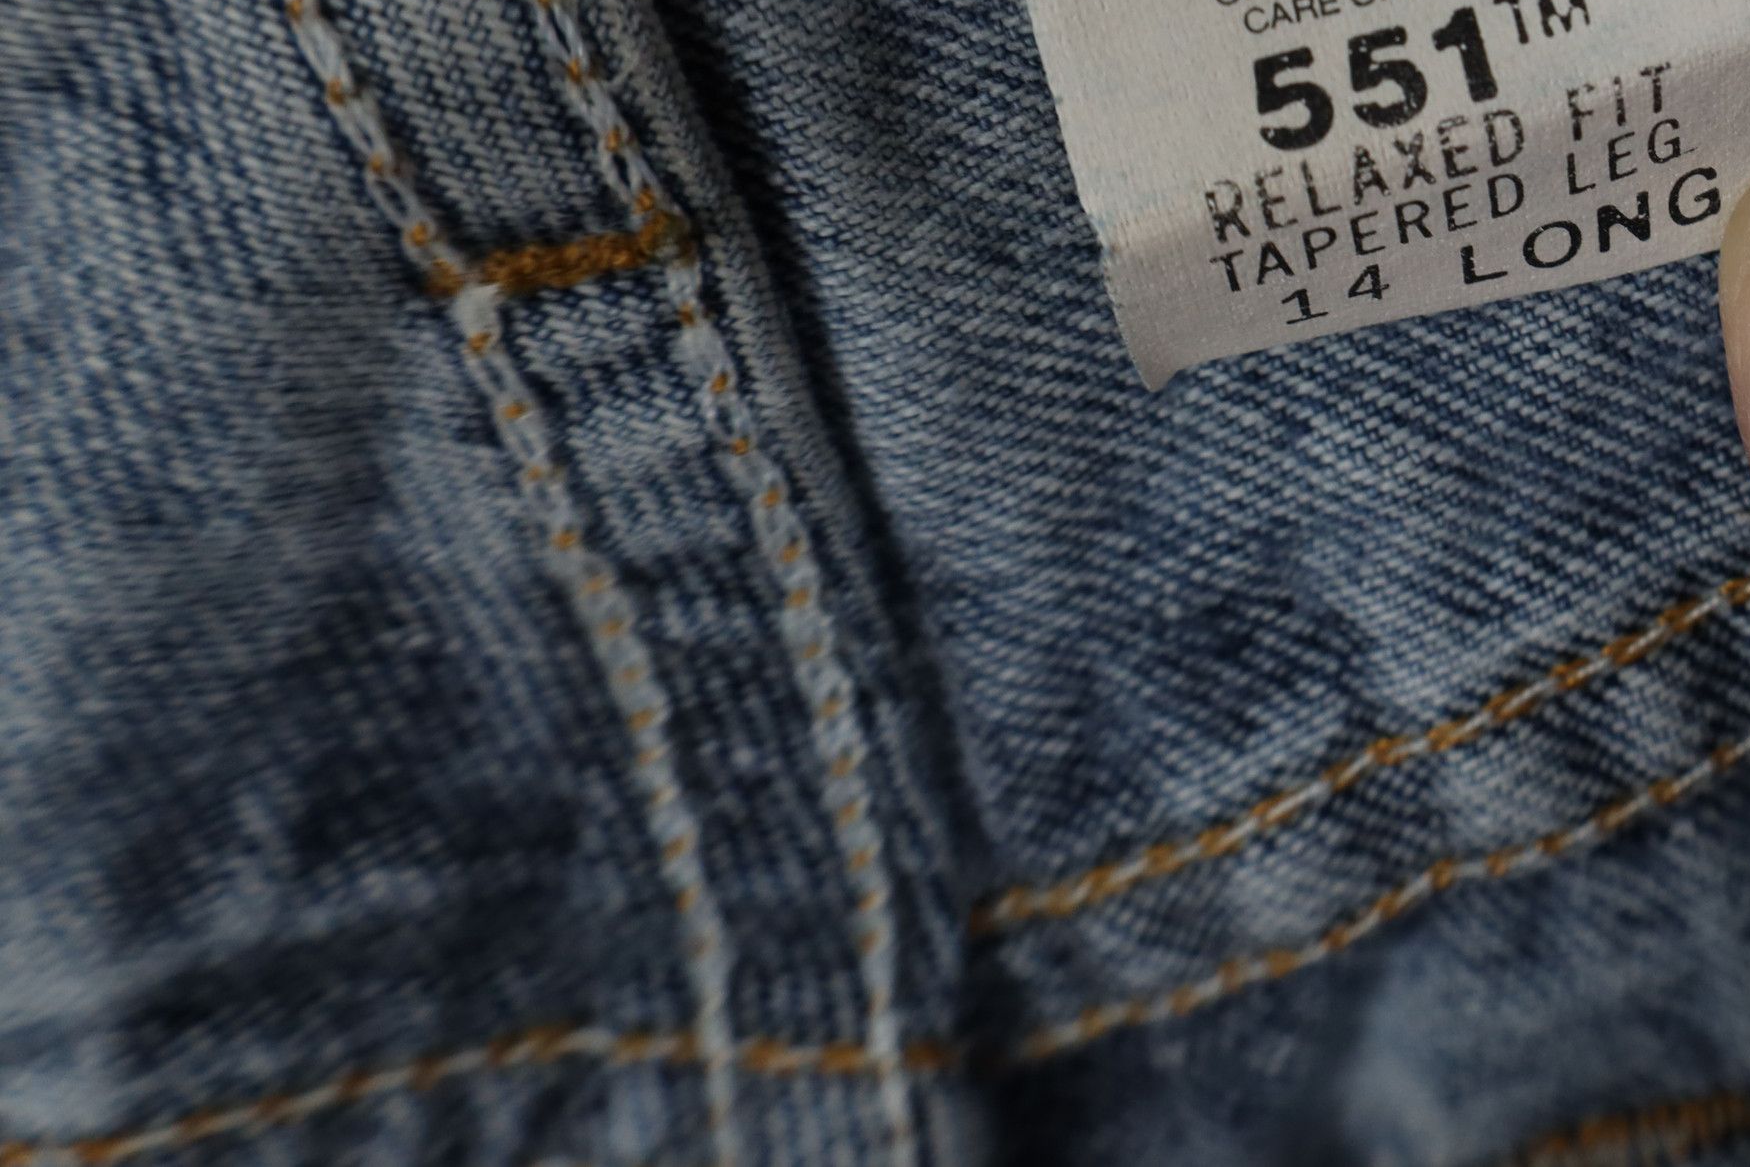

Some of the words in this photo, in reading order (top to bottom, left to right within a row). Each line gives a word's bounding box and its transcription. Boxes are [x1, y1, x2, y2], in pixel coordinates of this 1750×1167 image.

[1205, 110, 1524, 244] RELAXED
[1566, 62, 1671, 142] FIT
[1210, 172, 1524, 293] TAPERED
[1567, 119, 1681, 195] LEG
[1281, 264, 1390, 325] 14
[1460, 167, 1722, 285] LONG
